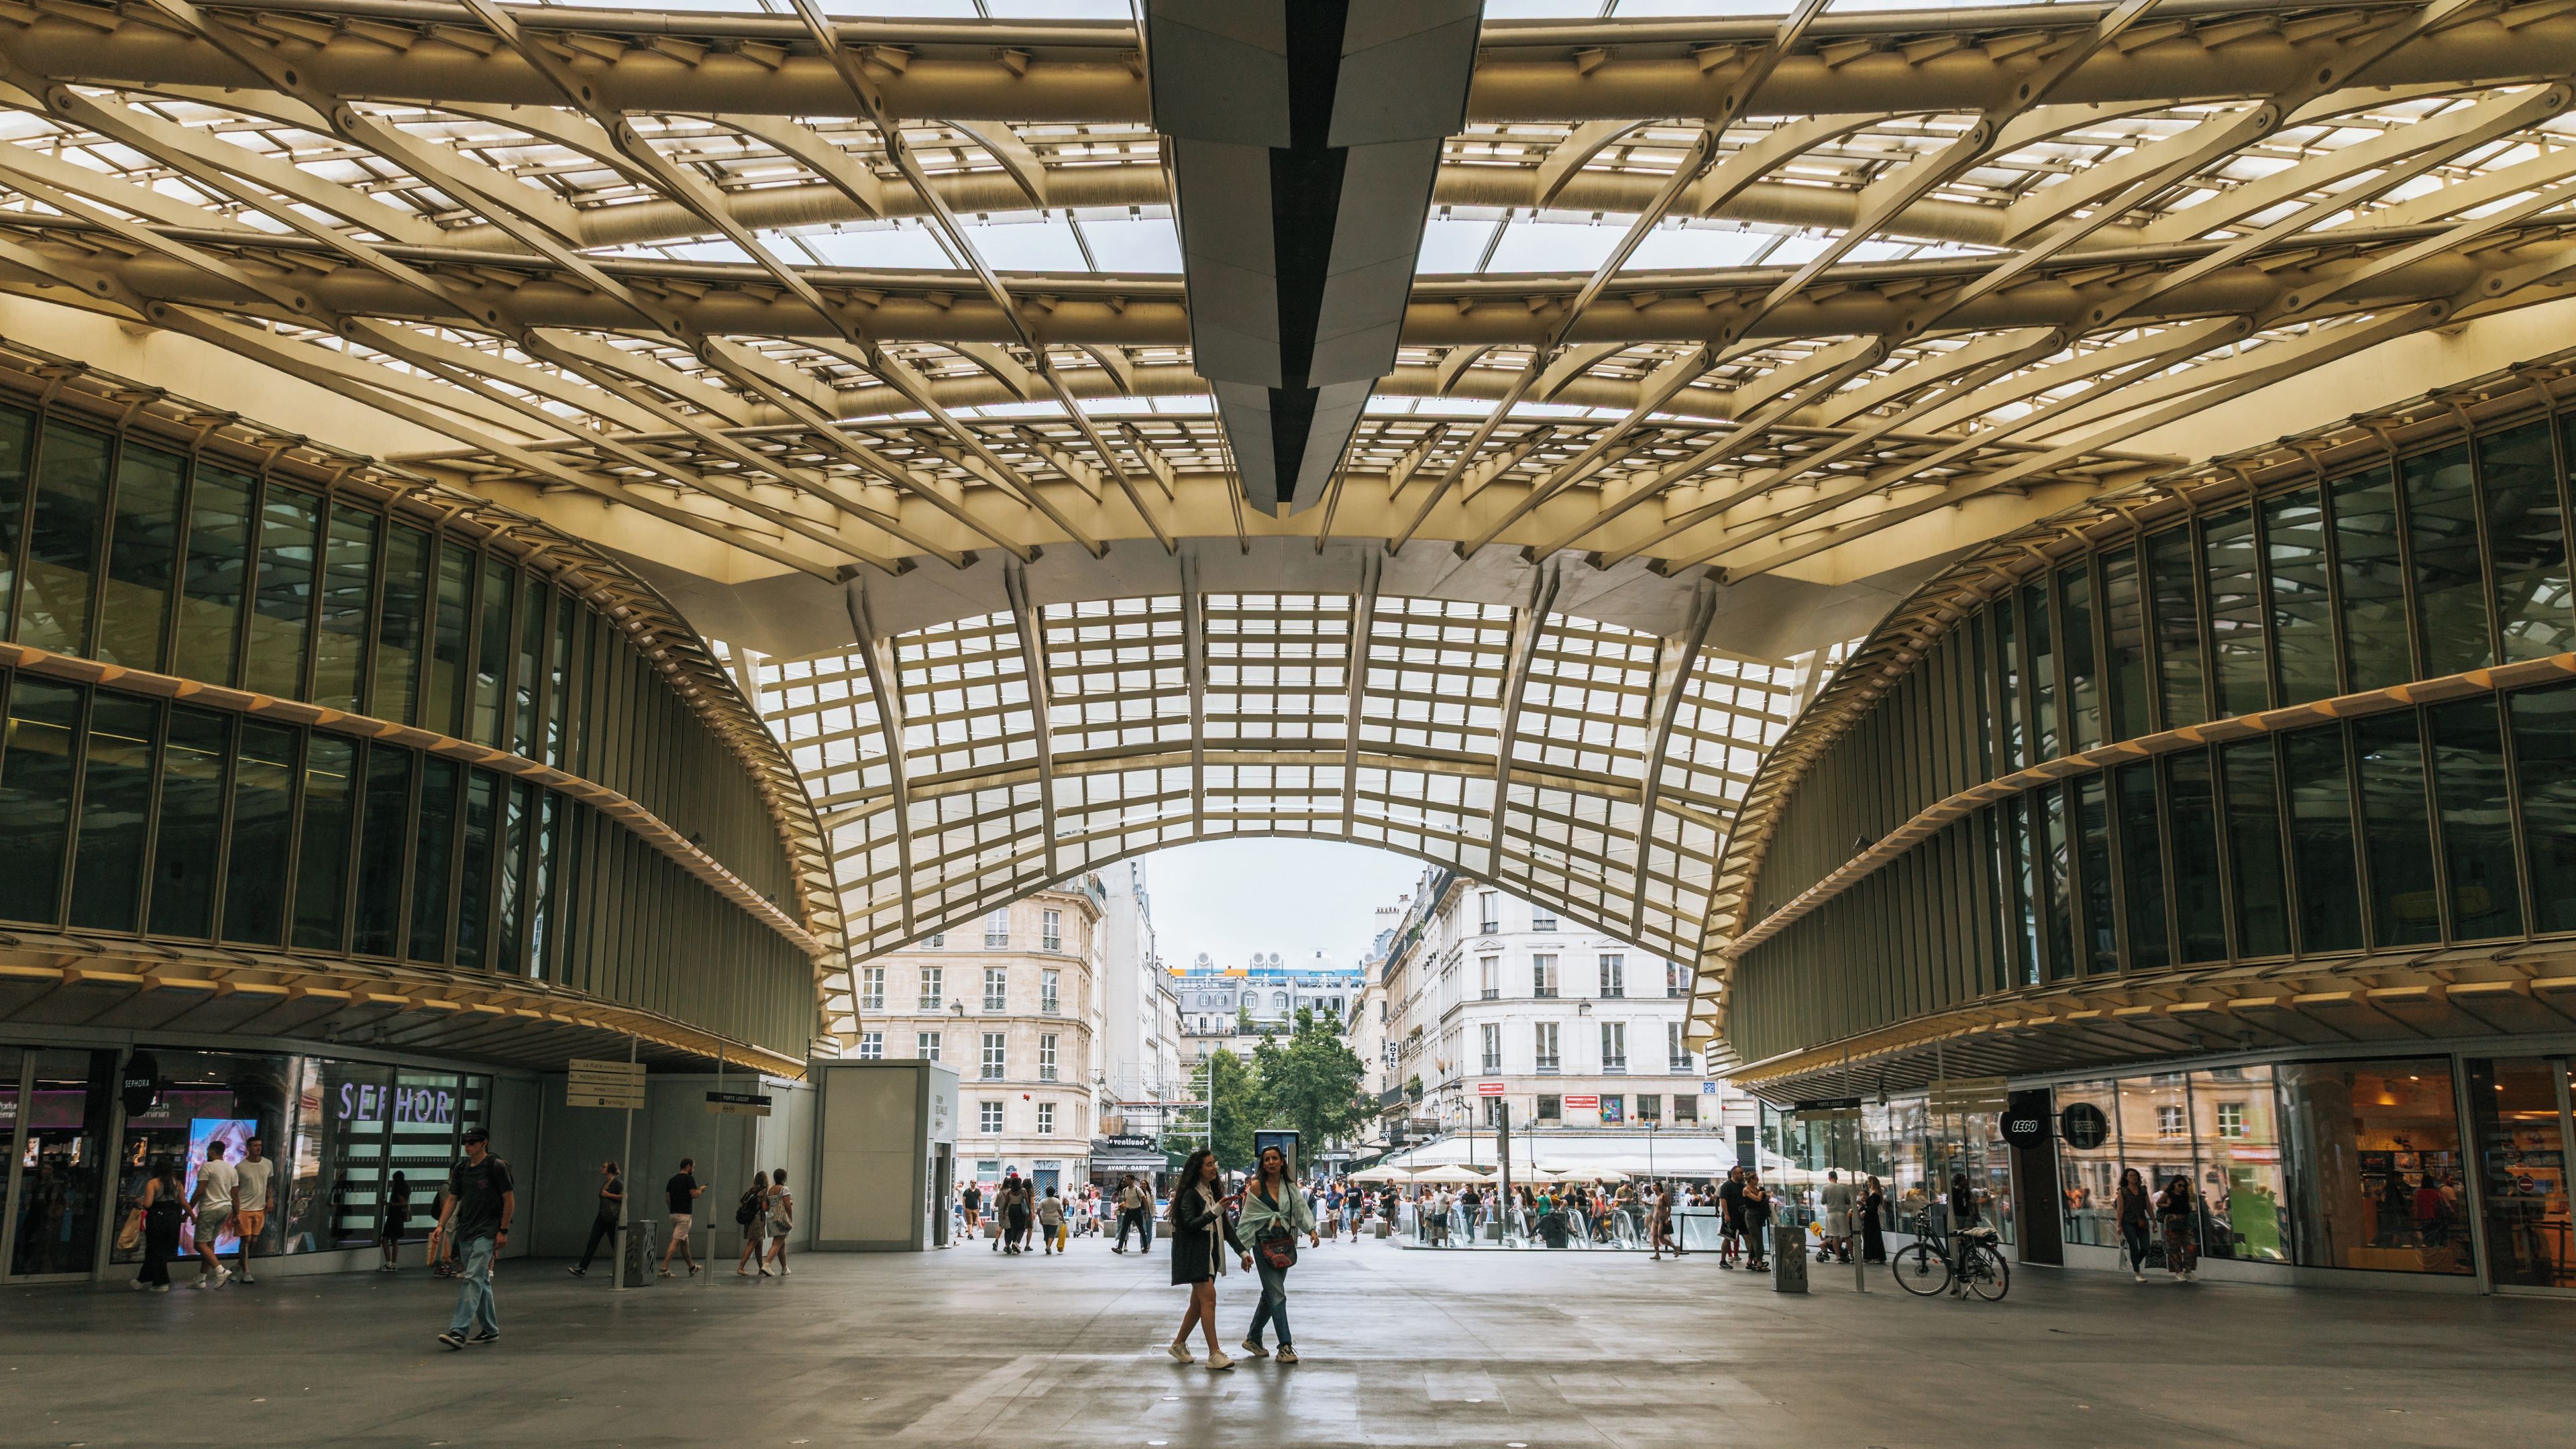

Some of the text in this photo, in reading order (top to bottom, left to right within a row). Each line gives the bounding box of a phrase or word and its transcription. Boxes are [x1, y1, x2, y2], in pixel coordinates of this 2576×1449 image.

[125, 1079, 150, 1088] SEPHORA
[339, 1082, 455, 1124] SEPHOR
[2012, 1120, 2038, 1132] LEGO
[1114, 1138, 1144, 1146] ventiuno
